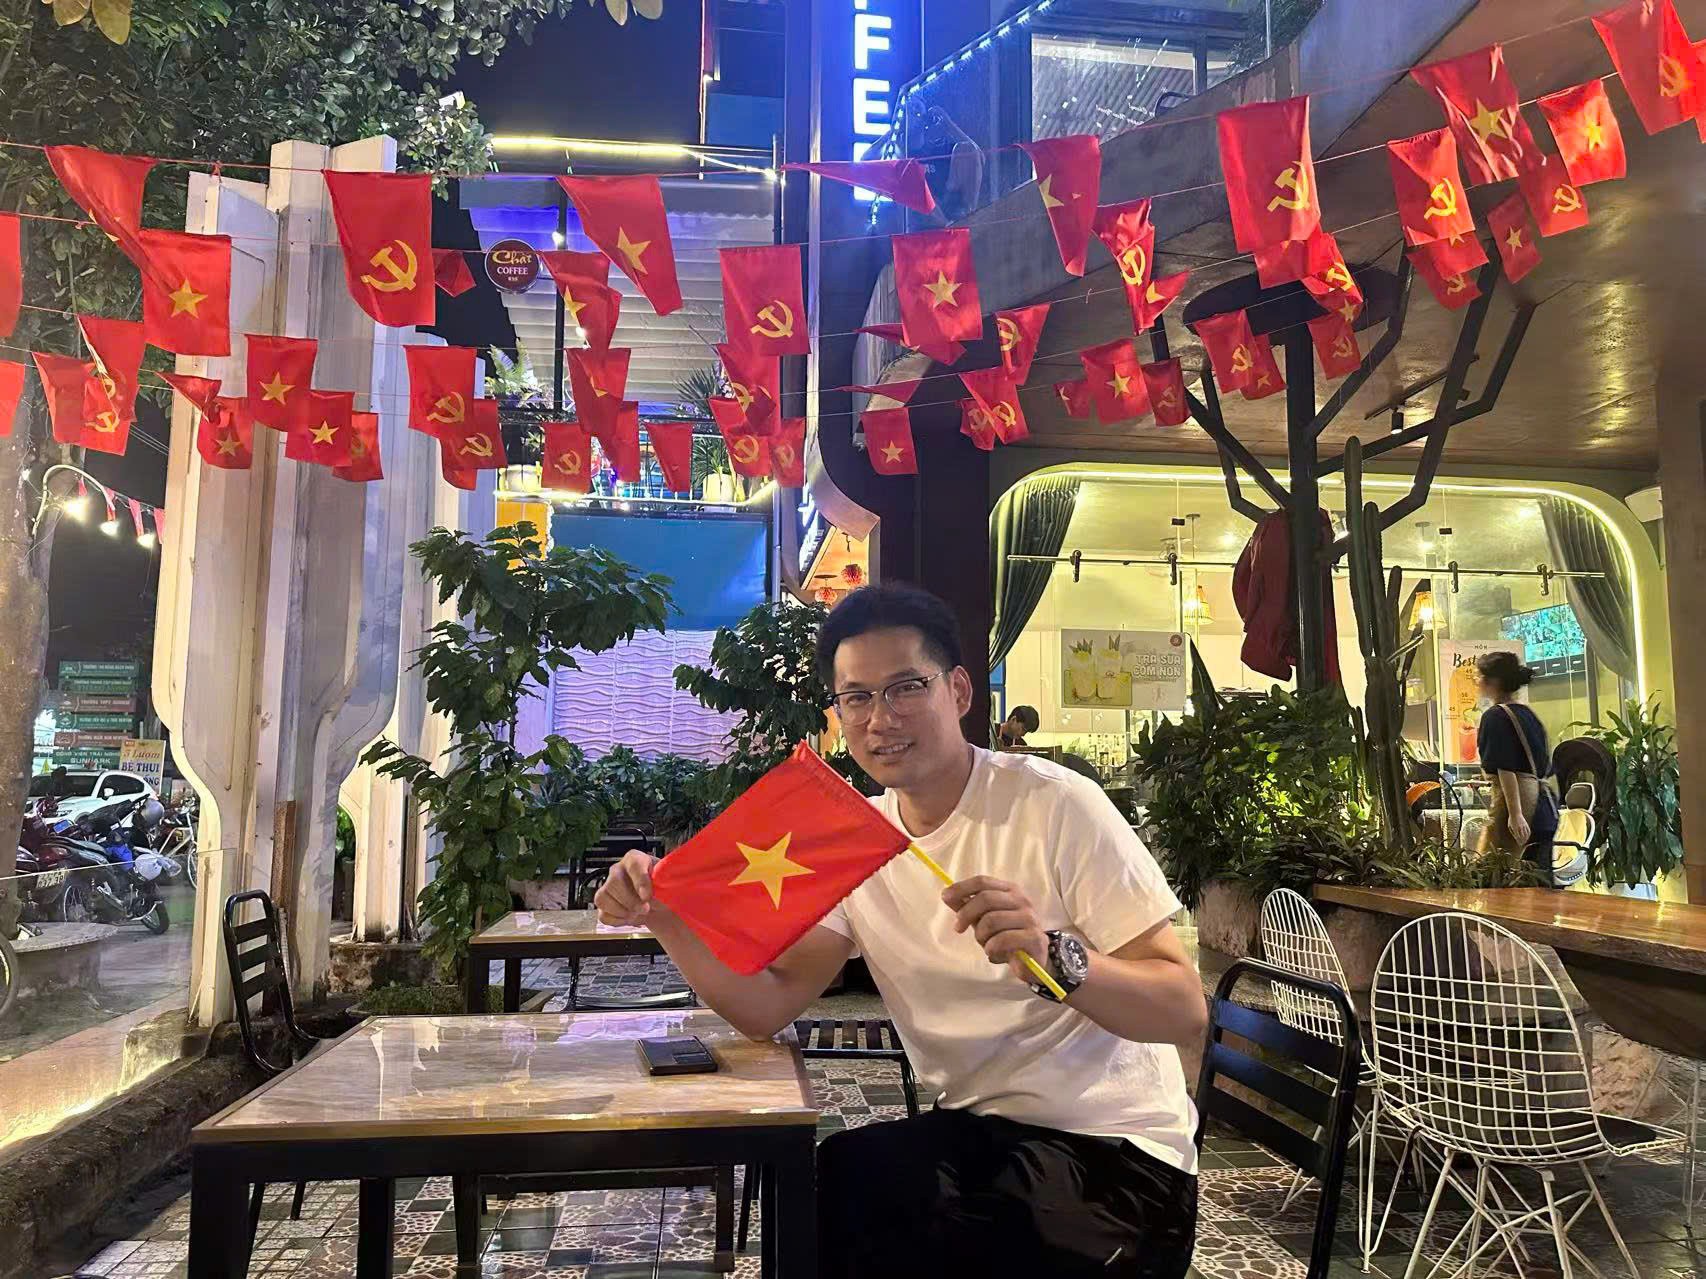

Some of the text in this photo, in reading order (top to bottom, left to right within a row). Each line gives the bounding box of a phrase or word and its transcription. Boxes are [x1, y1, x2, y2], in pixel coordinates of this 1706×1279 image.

[497, 266, 529, 275] COFFEE
[1453, 652, 1477, 668] Best
[136, 762, 160, 773] THUI
